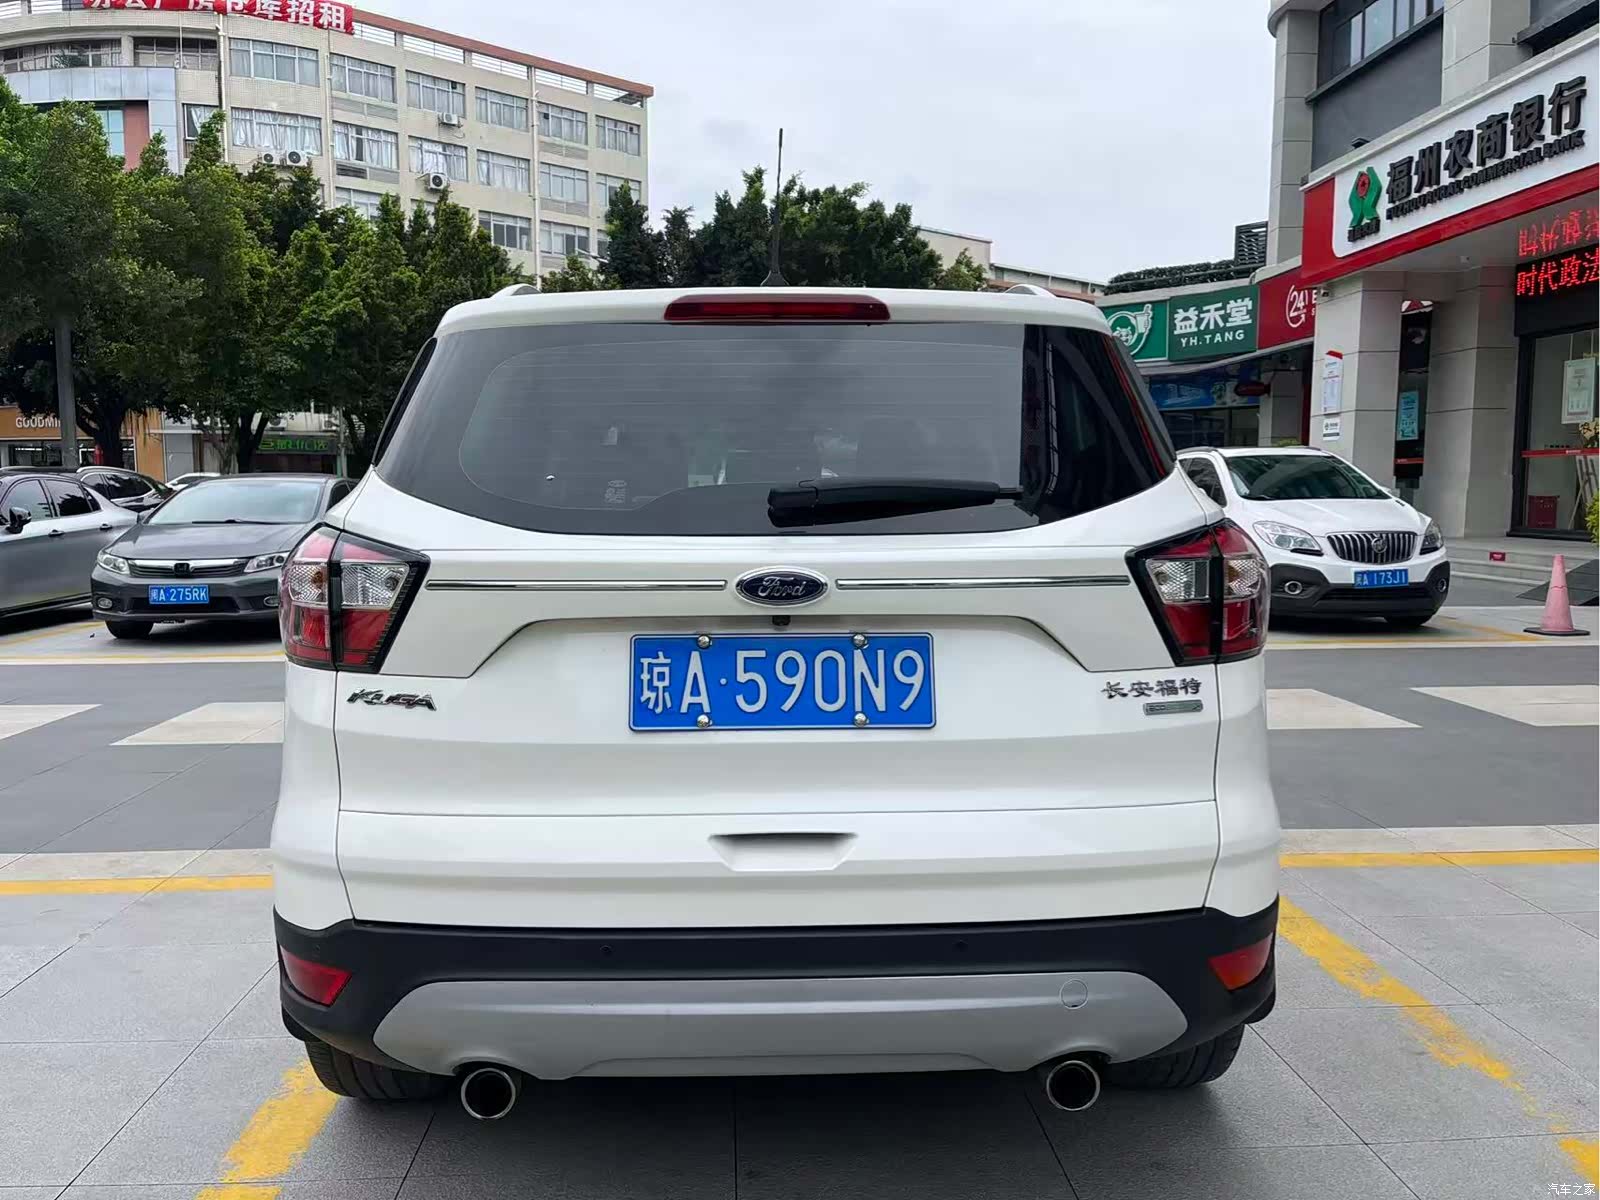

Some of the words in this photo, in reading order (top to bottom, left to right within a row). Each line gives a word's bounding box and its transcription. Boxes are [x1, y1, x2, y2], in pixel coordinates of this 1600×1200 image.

[1386, 76, 1587, 204] 福州农商银行
[1461, 147, 1544, 190] COMMERCIAL
[1543, 130, 1585, 159] BANK
[1173, 297, 1253, 335] 益禾堂
[1180, 329, 1246, 348] YH.TANG
[757, 575, 807, 598] Ford
[1101, 677, 1202, 699] 长安福特
[346, 689, 437, 712] KUGA
